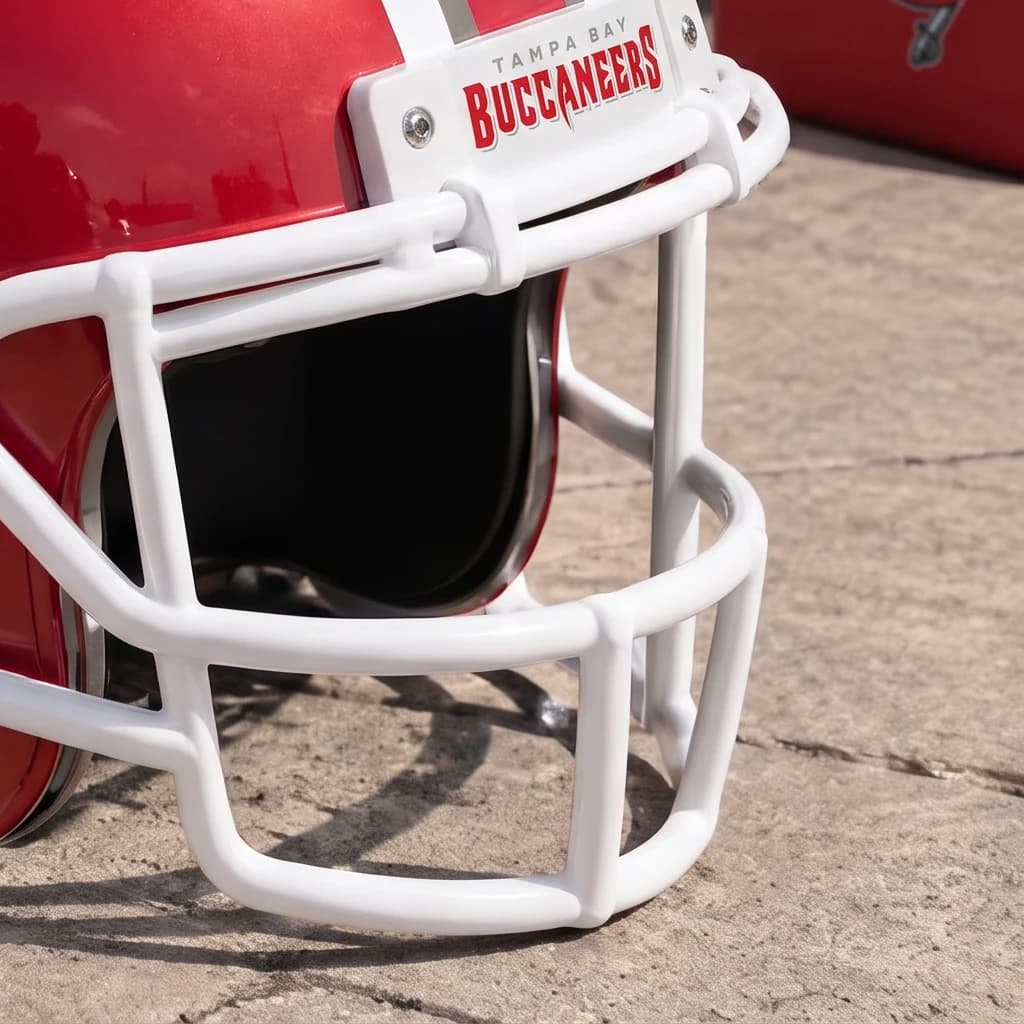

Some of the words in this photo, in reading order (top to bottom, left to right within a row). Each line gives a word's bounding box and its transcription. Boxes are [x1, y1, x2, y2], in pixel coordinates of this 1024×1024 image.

[462, 24, 664, 153] BUCCANEERS
[492, 35, 576, 74] TAMPA
[589, 17, 628, 43] BAY
